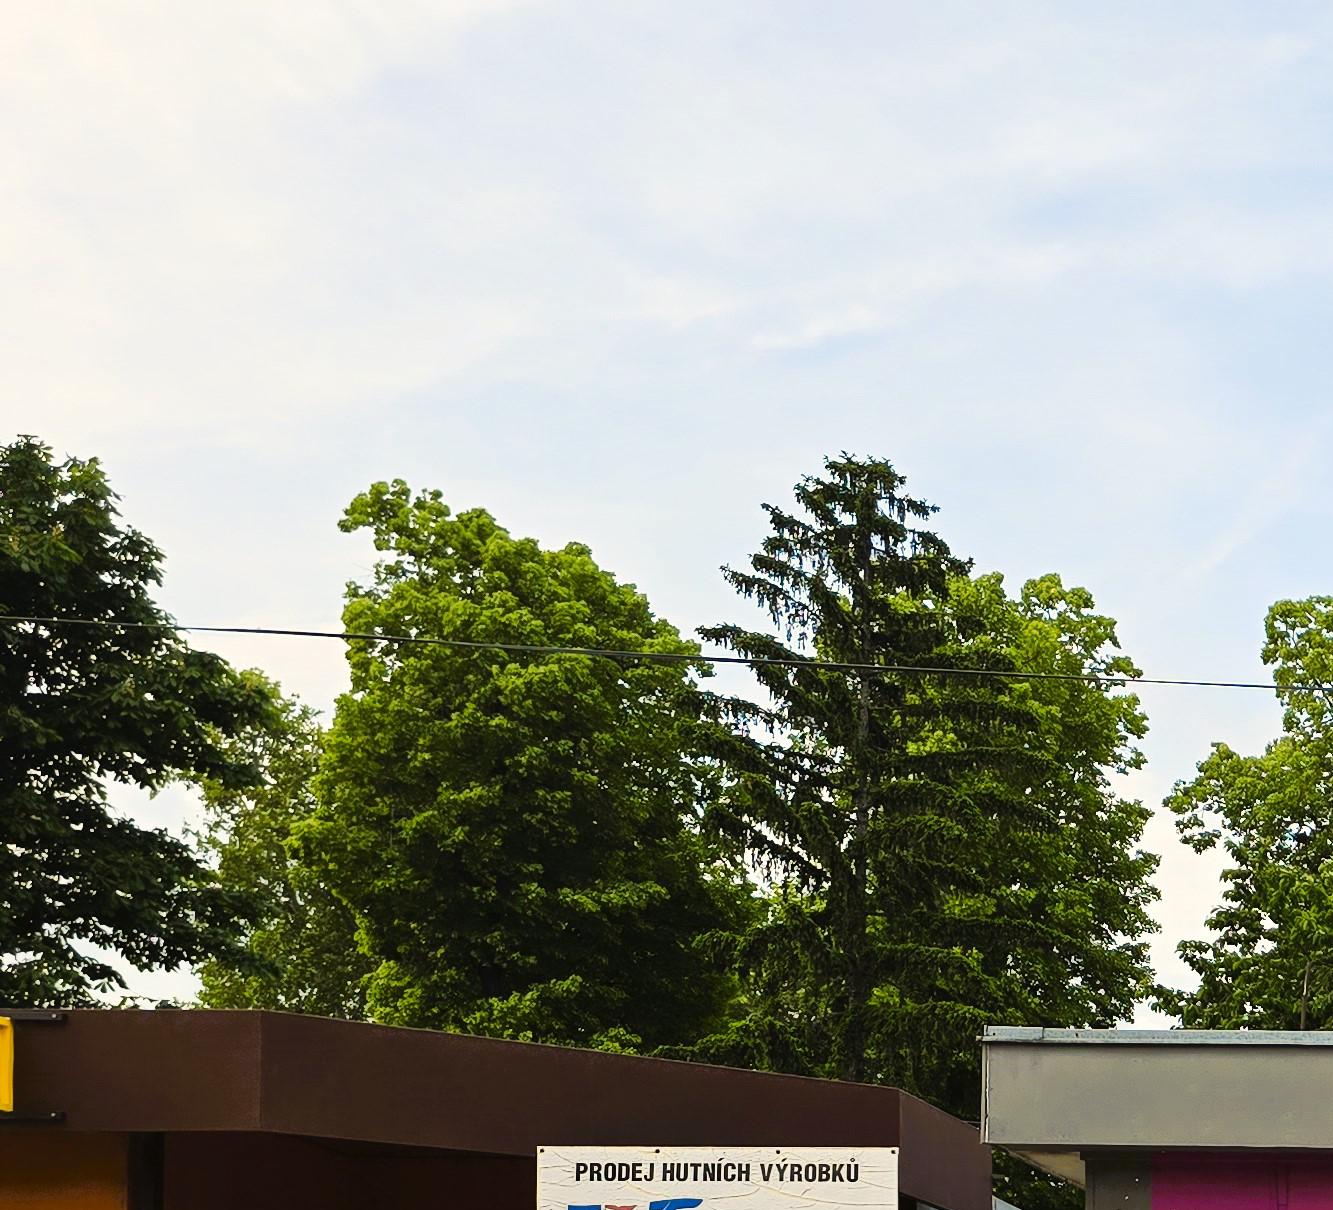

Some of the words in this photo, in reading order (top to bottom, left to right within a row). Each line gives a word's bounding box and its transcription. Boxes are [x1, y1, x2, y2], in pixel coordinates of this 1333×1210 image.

[575, 1163, 655, 1182] PRODEJ
[662, 1157, 750, 1182] HUTNÍCH
[761, 1158, 859, 1183] VÝROBKŮ
